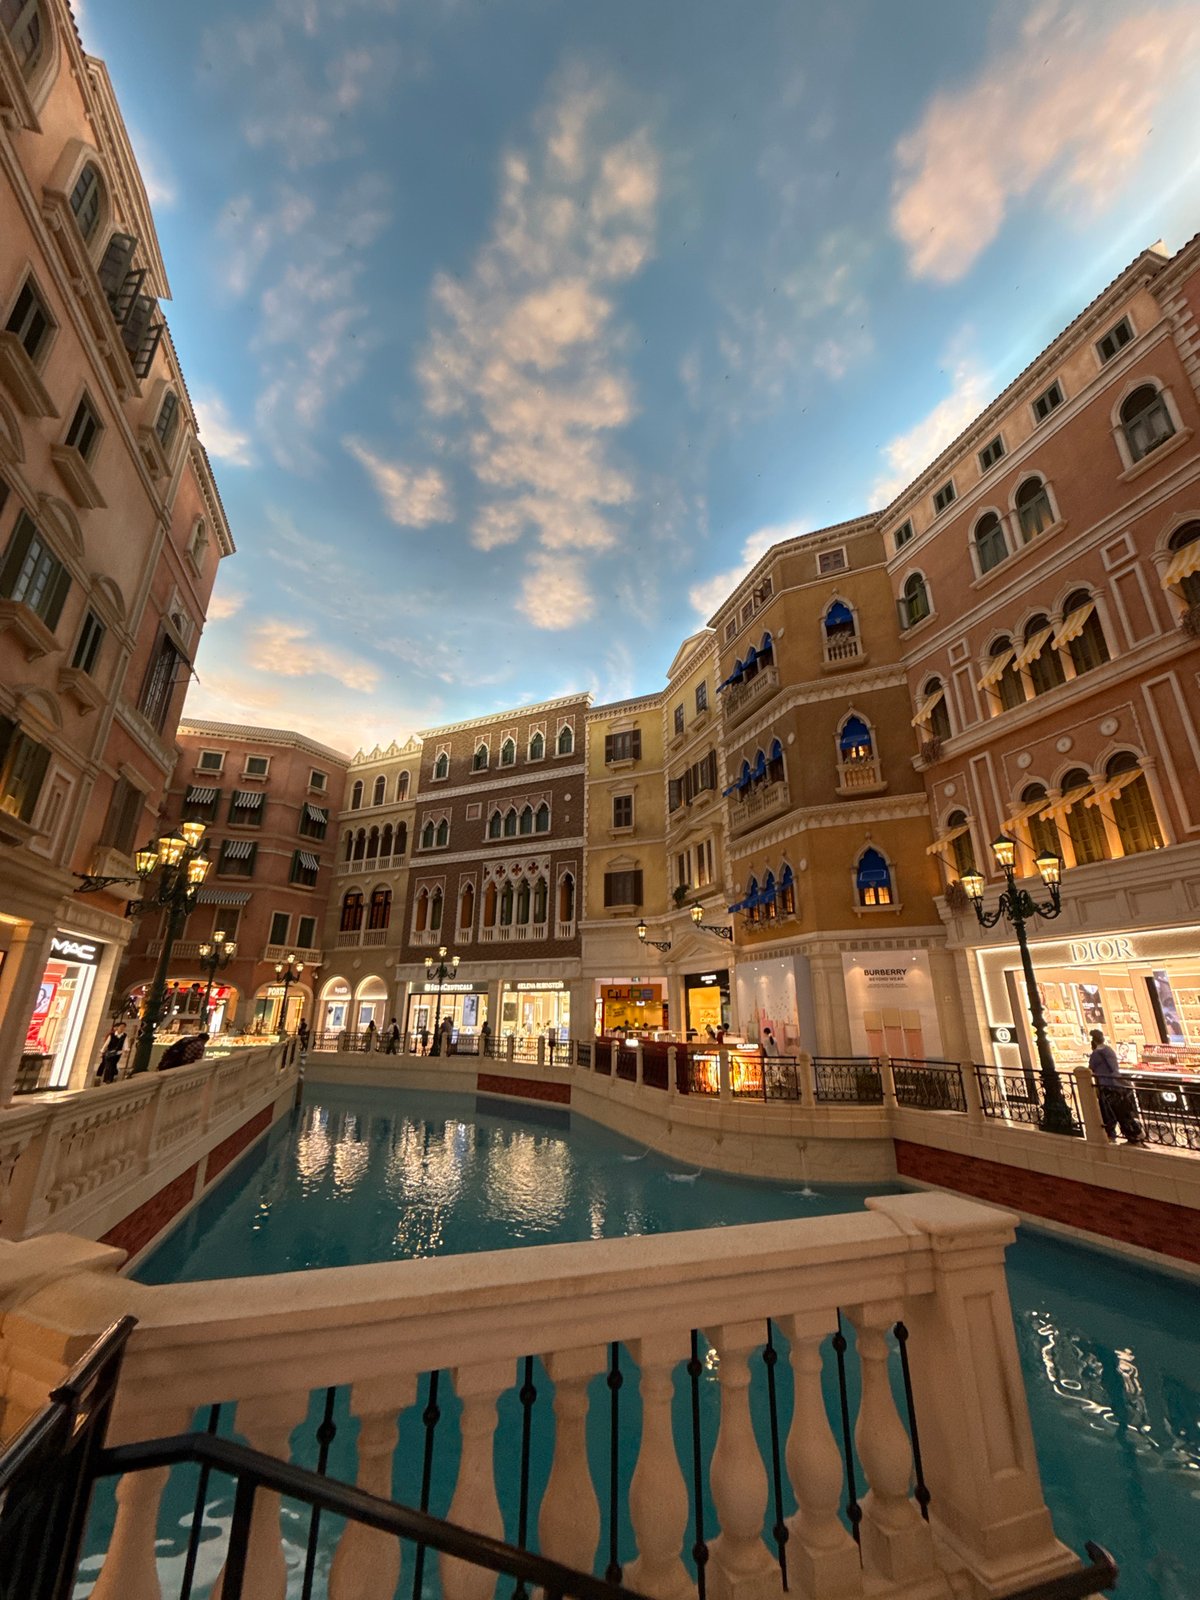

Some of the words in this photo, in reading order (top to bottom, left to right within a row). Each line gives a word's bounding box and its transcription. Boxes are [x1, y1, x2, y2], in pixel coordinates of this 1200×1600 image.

[51, 937, 96, 960] MAC
[1070, 938, 1136, 962] DIOR
[863, 968, 907, 976] BURBERRY
